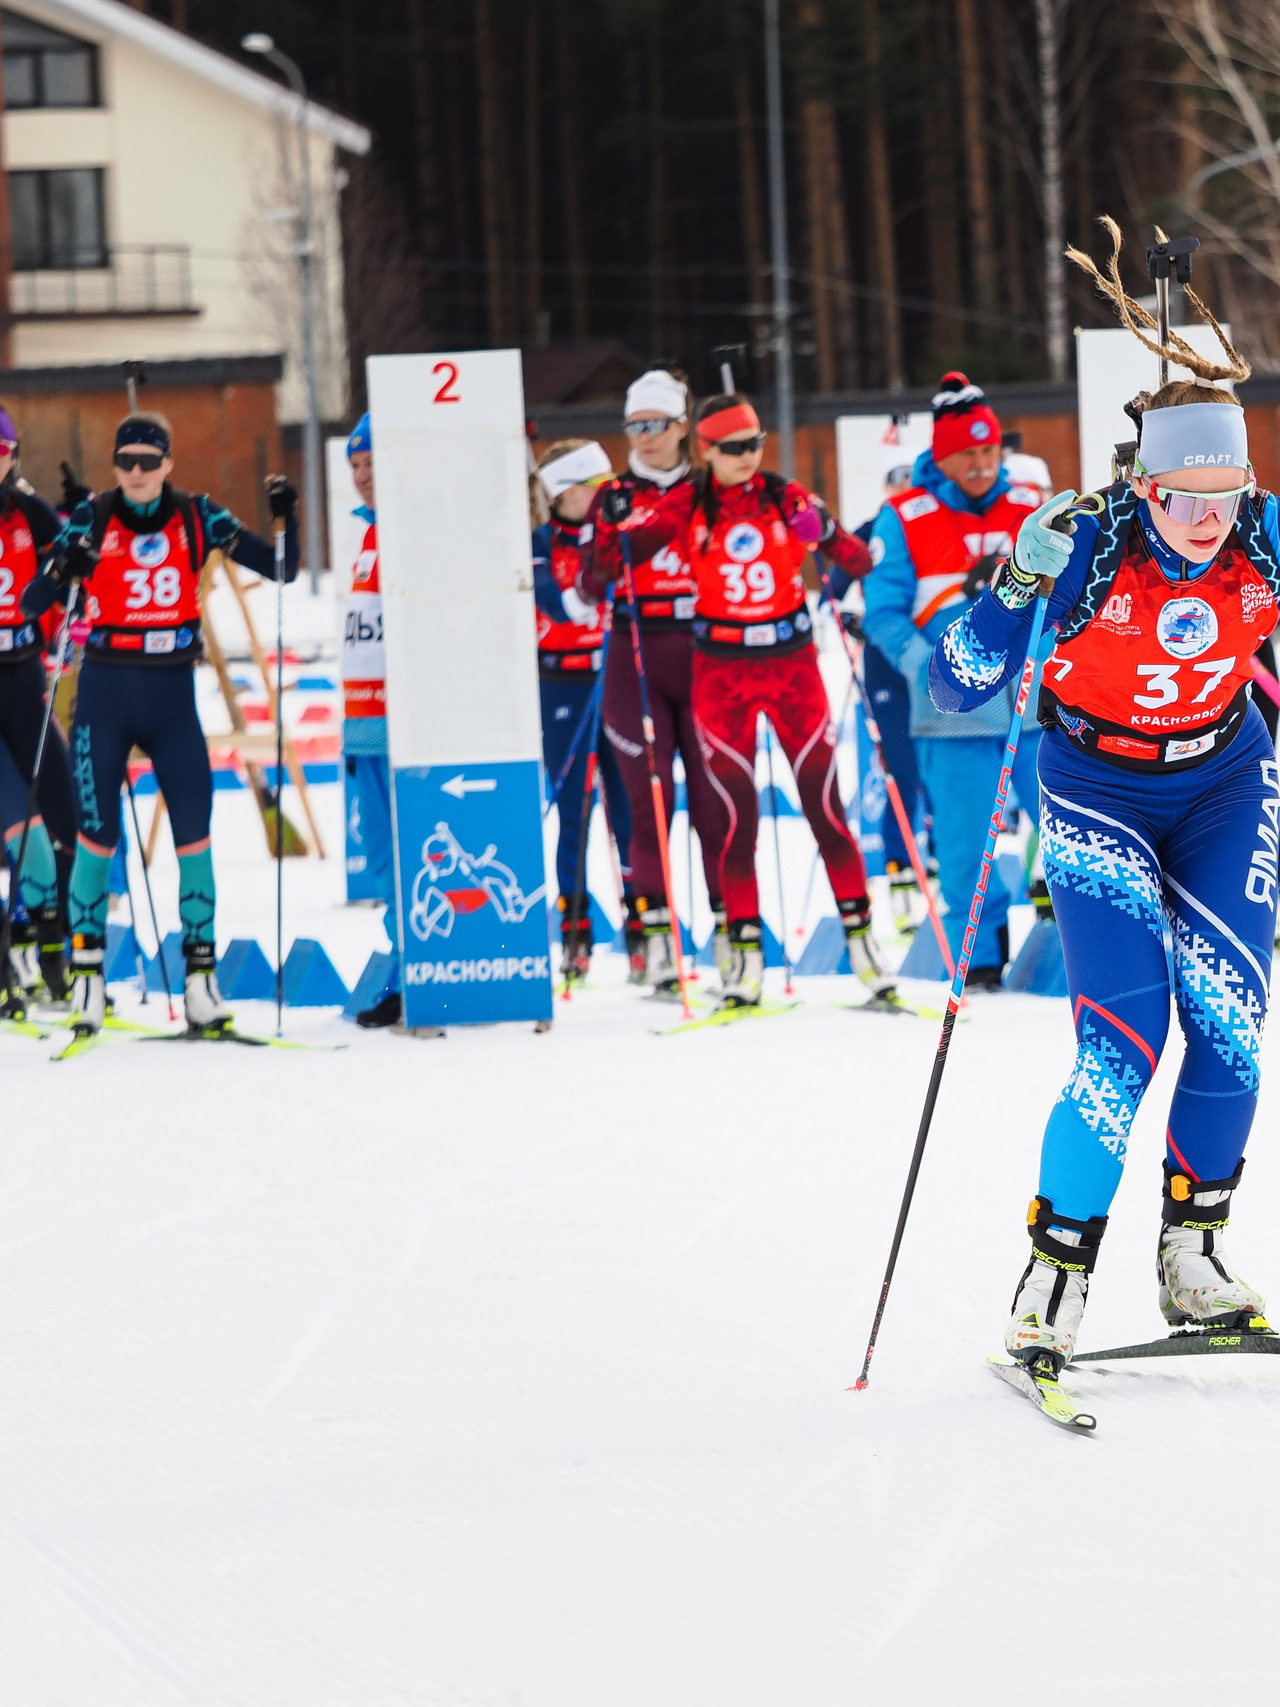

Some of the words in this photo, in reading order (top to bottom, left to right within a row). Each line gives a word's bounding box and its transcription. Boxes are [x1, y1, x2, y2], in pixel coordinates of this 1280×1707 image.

[432, 361, 461, 404] 2
[1184, 455, 1231, 466] CRAFT
[124, 567, 181, 609] 38
[719, 561, 775, 603] 39
[1133, 655, 1237, 710] 37
[1130, 701, 1224, 726] КРАСНОЯРСК
[406, 955, 549, 986] КРАСНОЯРСК
[1208, 1336, 1242, 1346] FISCHER
